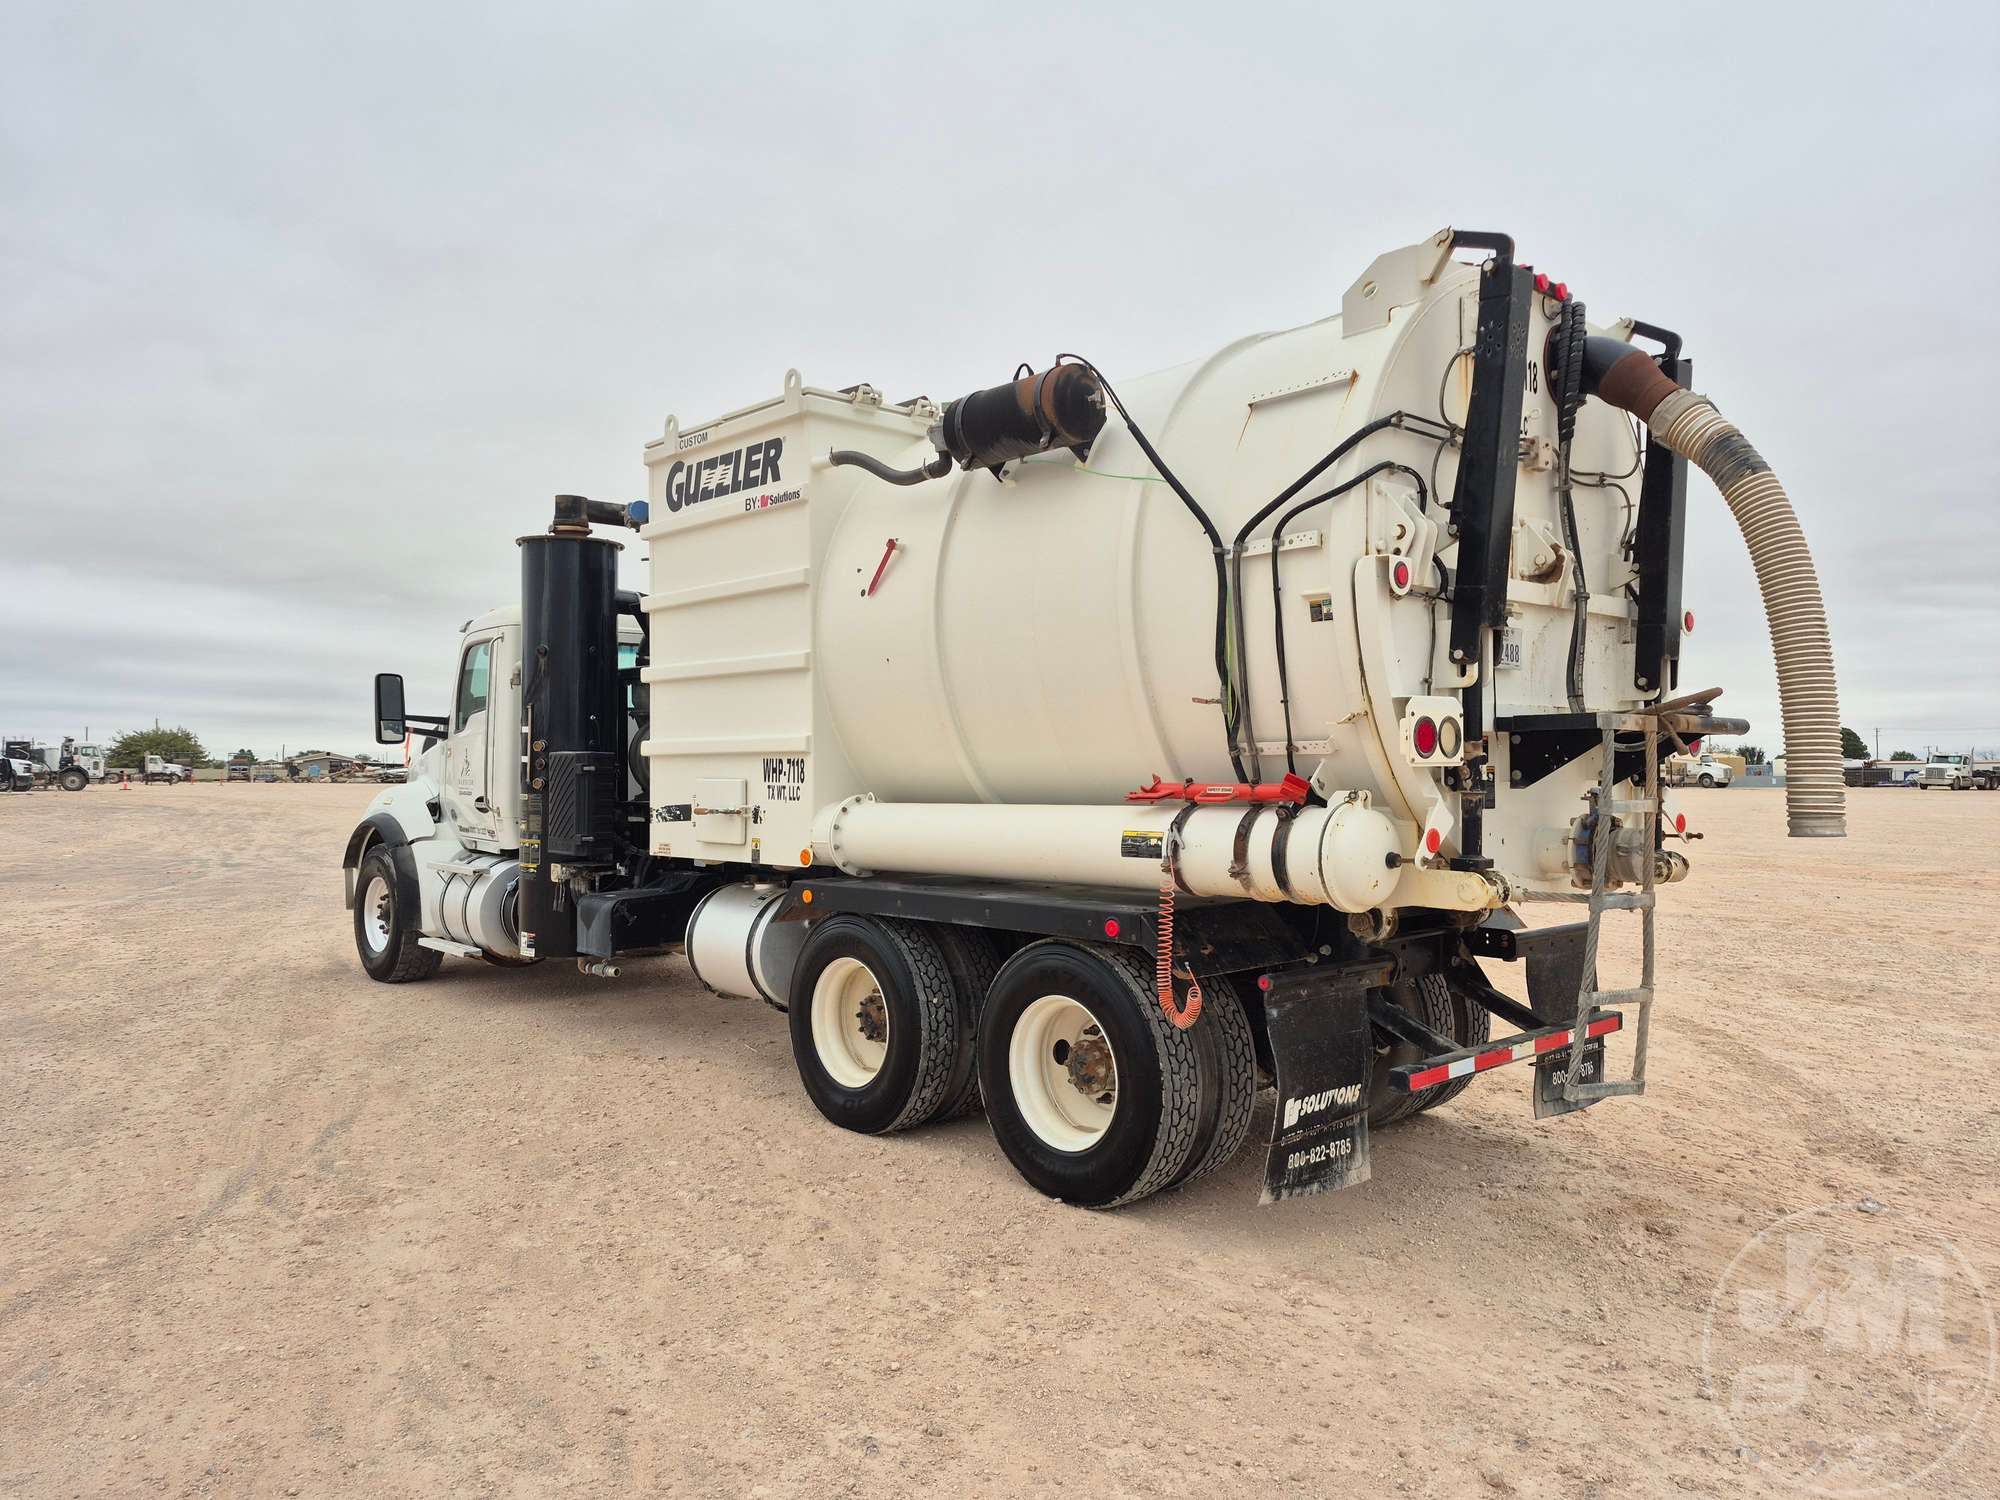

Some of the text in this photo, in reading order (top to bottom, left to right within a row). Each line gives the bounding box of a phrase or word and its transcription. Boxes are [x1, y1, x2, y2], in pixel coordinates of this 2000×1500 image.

[679, 432, 708, 450] CUSTOM
[666, 437, 783, 513] GUZZLER
[745, 496, 760, 511] BY:
[769, 490, 800, 505] Solutions
[763, 758, 805, 784] WHP-7118
[767, 785, 776, 801] TX
[788, 784, 801, 801] LLC
[1300, 1083, 1361, 1117] SOLUTIONS
[1288, 1138, 1352, 1169] 800-822-8785
